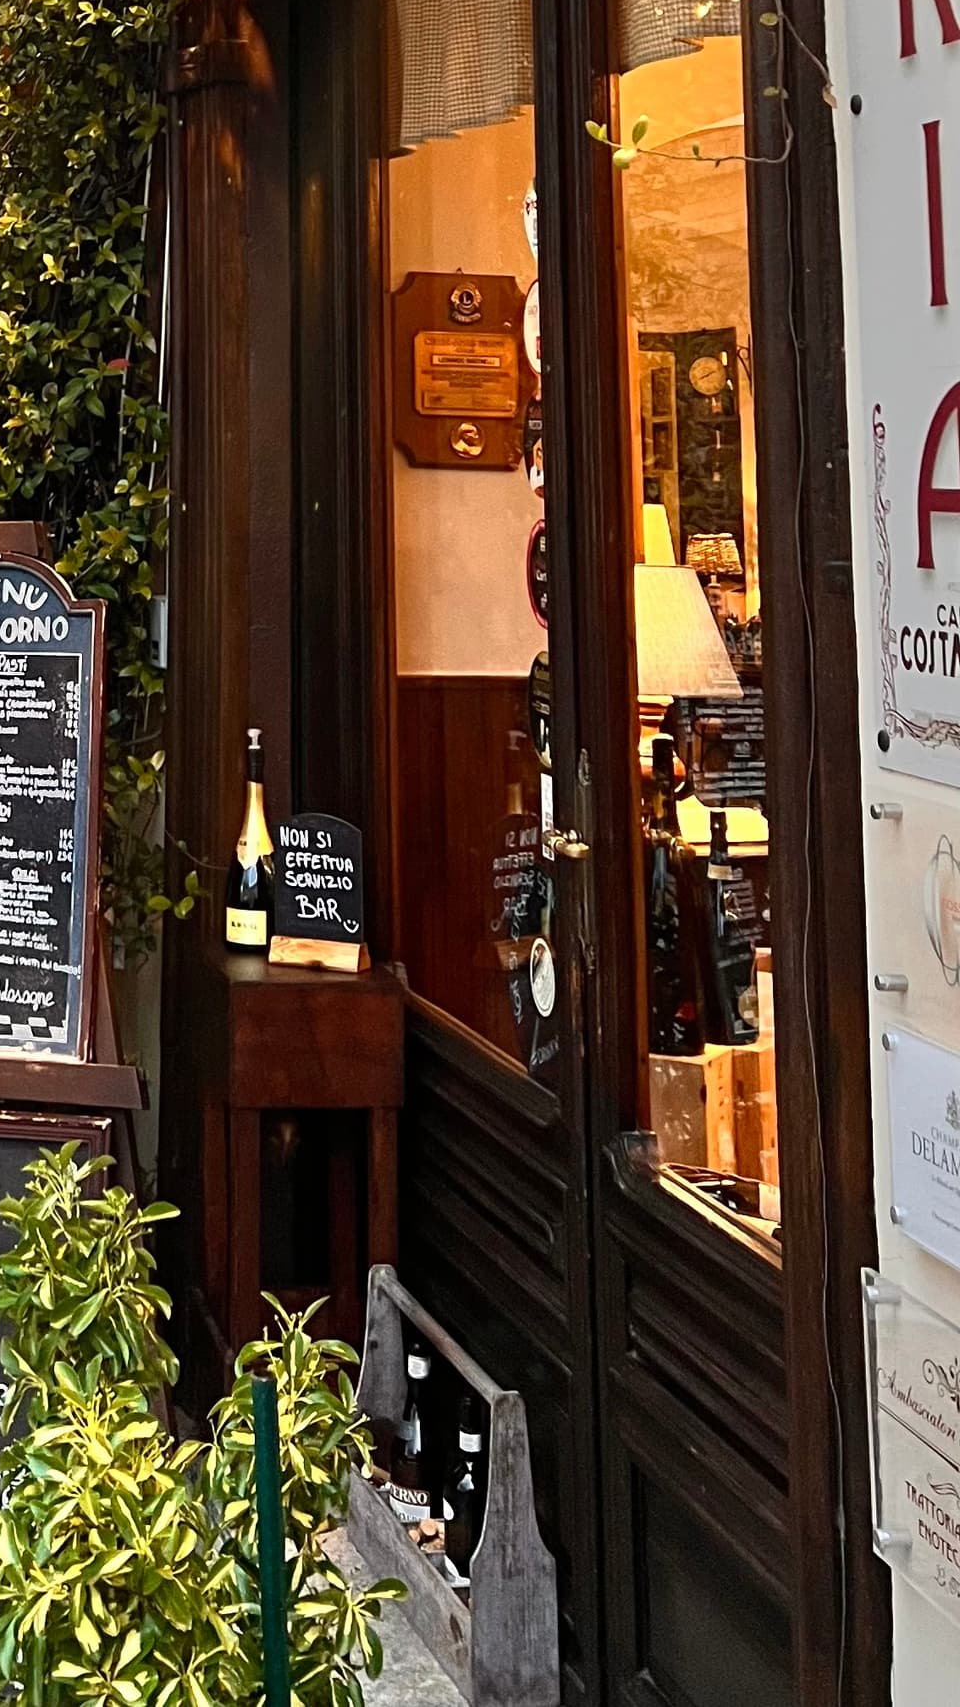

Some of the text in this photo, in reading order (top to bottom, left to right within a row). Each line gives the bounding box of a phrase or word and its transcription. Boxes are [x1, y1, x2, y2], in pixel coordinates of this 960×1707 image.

[936, 604, 960, 628] CA
[280, 826, 332, 848] NON SI
[285, 852, 354, 873] EFFETTUA
[285, 871, 353, 891] SERVIZIO
[295, 895, 342, 922] BAR
